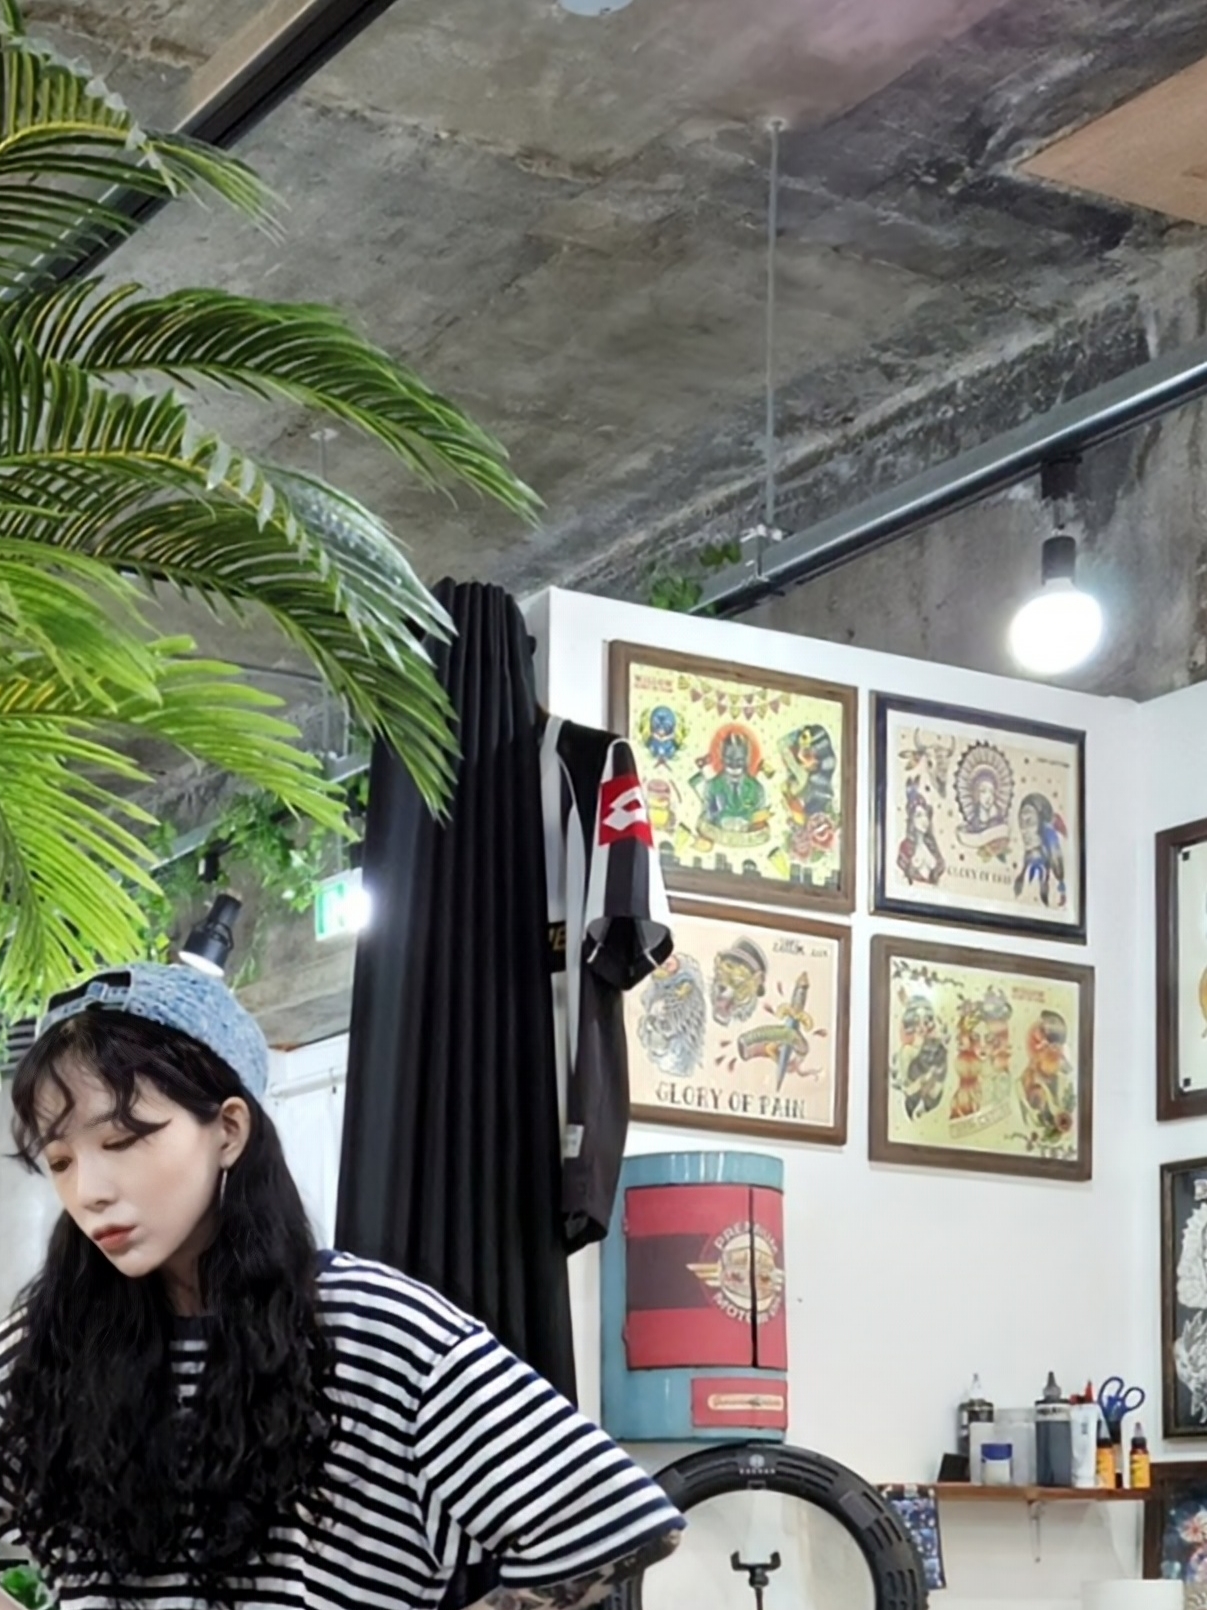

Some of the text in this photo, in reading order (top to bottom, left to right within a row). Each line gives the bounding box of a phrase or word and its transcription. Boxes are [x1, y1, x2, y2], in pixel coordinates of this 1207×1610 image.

[655, 1081, 806, 1120] GLORY OF PAIN
